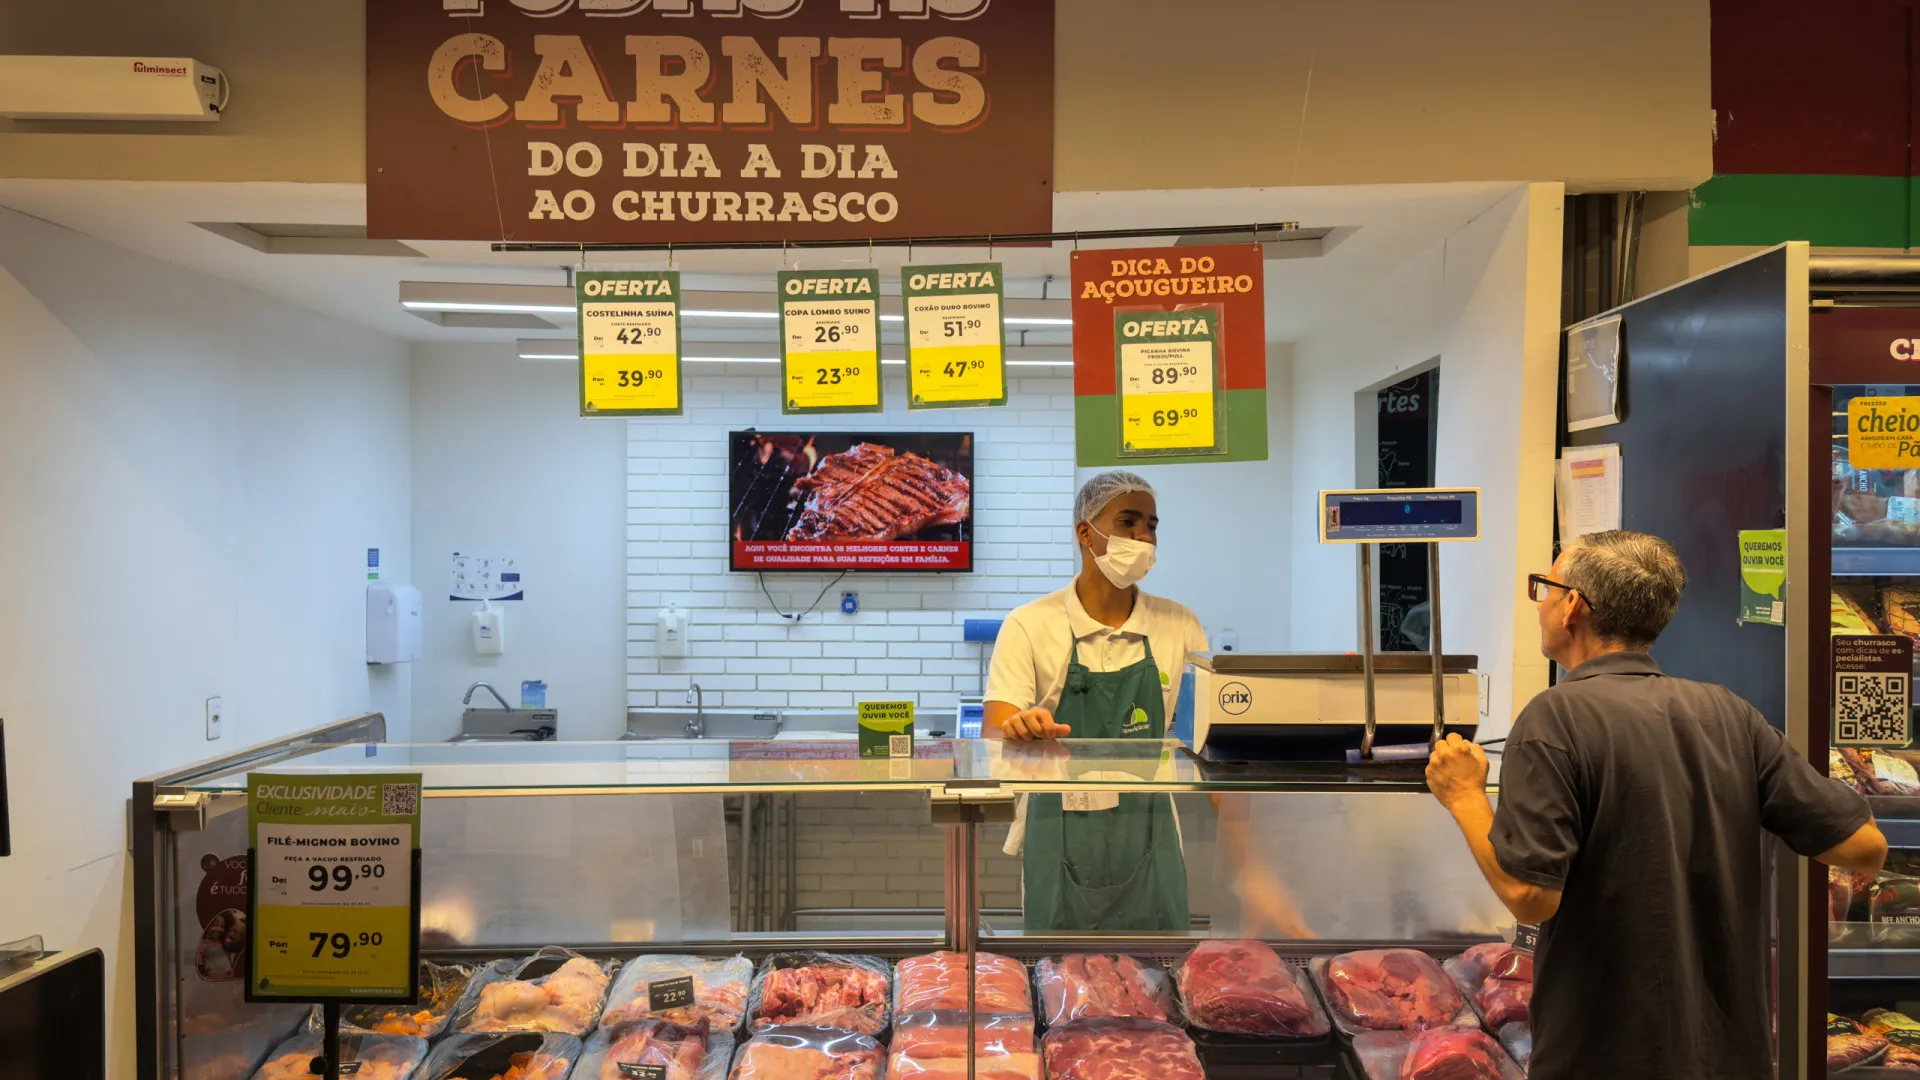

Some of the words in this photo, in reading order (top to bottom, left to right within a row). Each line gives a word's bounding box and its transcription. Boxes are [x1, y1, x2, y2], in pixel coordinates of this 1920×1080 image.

[427, 32, 988, 129] CARNES
[527, 141, 603, 177] DO
[623, 142, 721, 178] DIA
[740, 143, 781, 178] A
[800, 143, 898, 179] DIA
[528, 189, 595, 221] AO
[612, 190, 898, 222] CHURRASCO
[1111, 258, 1172, 277] DICA
[1180, 256, 1215, 274] DO
[584, 279, 672, 296] OFERTA
[785, 277, 872, 295] OFERTA
[909, 271, 995, 290] OFERTA
[1081, 275, 1253, 304] AÇOUGUEIRO
[646, 309, 674, 317] SUÍNA
[617, 327, 661, 344] 42,90
[815, 325, 859, 343] 26,90
[944, 320, 981, 337] 51,90
[1123, 319, 1209, 337] OFERTA
[817, 367, 860, 385] 23,90
[944, 360, 984, 378] 47,90
[1152, 366, 1197, 385] 89,90
[618, 370, 663, 387] 39,90
[1153, 408, 1198, 427] 69,90
[1858, 407, 1920, 433] cheio
[767, 544, 787, 552] VOCÊ
[1744, 542, 1782, 552] QUEREMOS
[858, 555, 899, 564] REFEIÇÕES
[1743, 556, 1763, 564] OUVIR
[1764, 554, 1784, 565] VOCÊ
[1222, 691, 1249, 706] prix
[256, 785, 377, 800] EXCLUSIVIDADE
[256, 802, 302, 815] Cliente
[267, 835, 346, 847] FILÉ-MIGNON
[351, 838, 400, 846] BOVINO
[238, 870, 247, 886] f
[272, 876, 287, 884] De:
[308, 864, 385, 891] 99,90
[210, 880, 219, 894] é
[309, 932, 383, 959] 79,90
